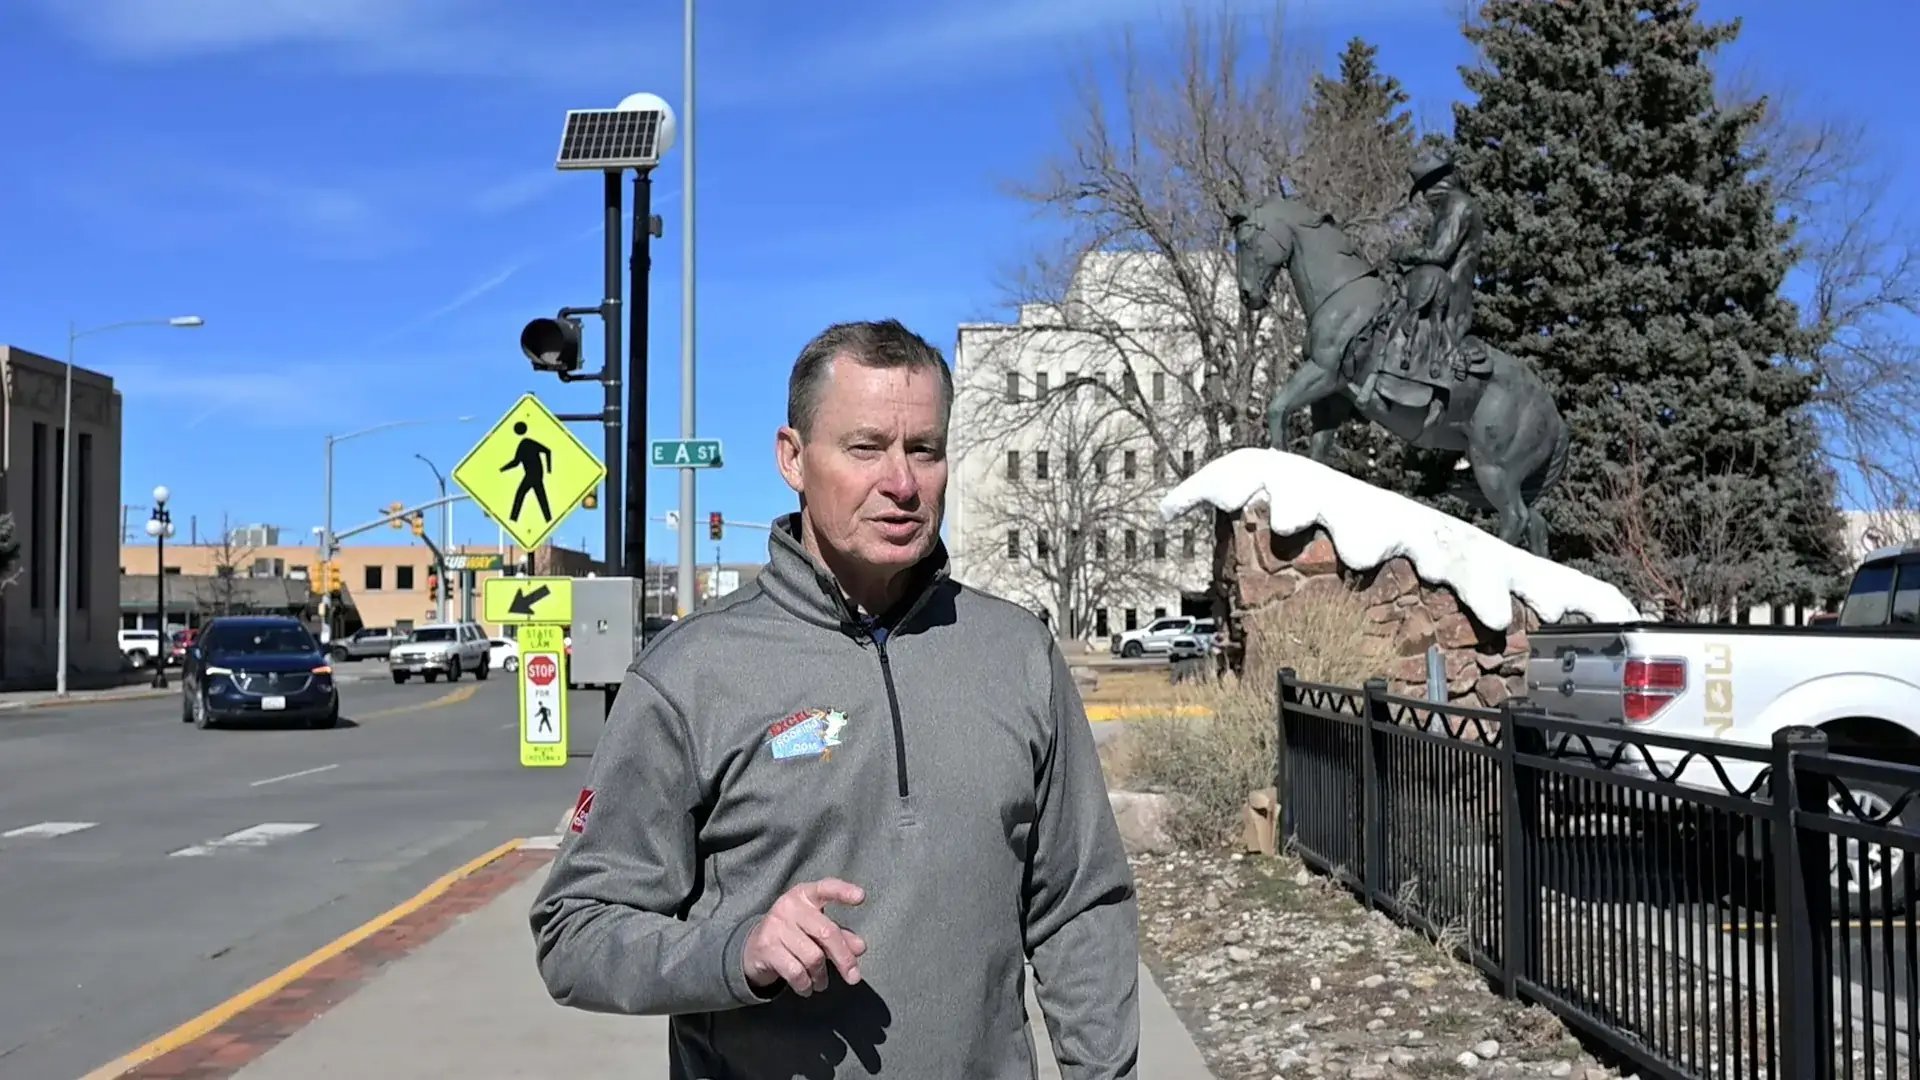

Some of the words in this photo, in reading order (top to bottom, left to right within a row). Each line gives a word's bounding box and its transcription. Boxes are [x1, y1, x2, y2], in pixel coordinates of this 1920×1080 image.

[654, 446, 664, 460] E
[674, 443, 690, 463] A
[698, 446, 716, 460] ST
[527, 629, 553, 638] STATE
[528, 664, 555, 678] STOP
[535, 688, 550, 697] FOR
